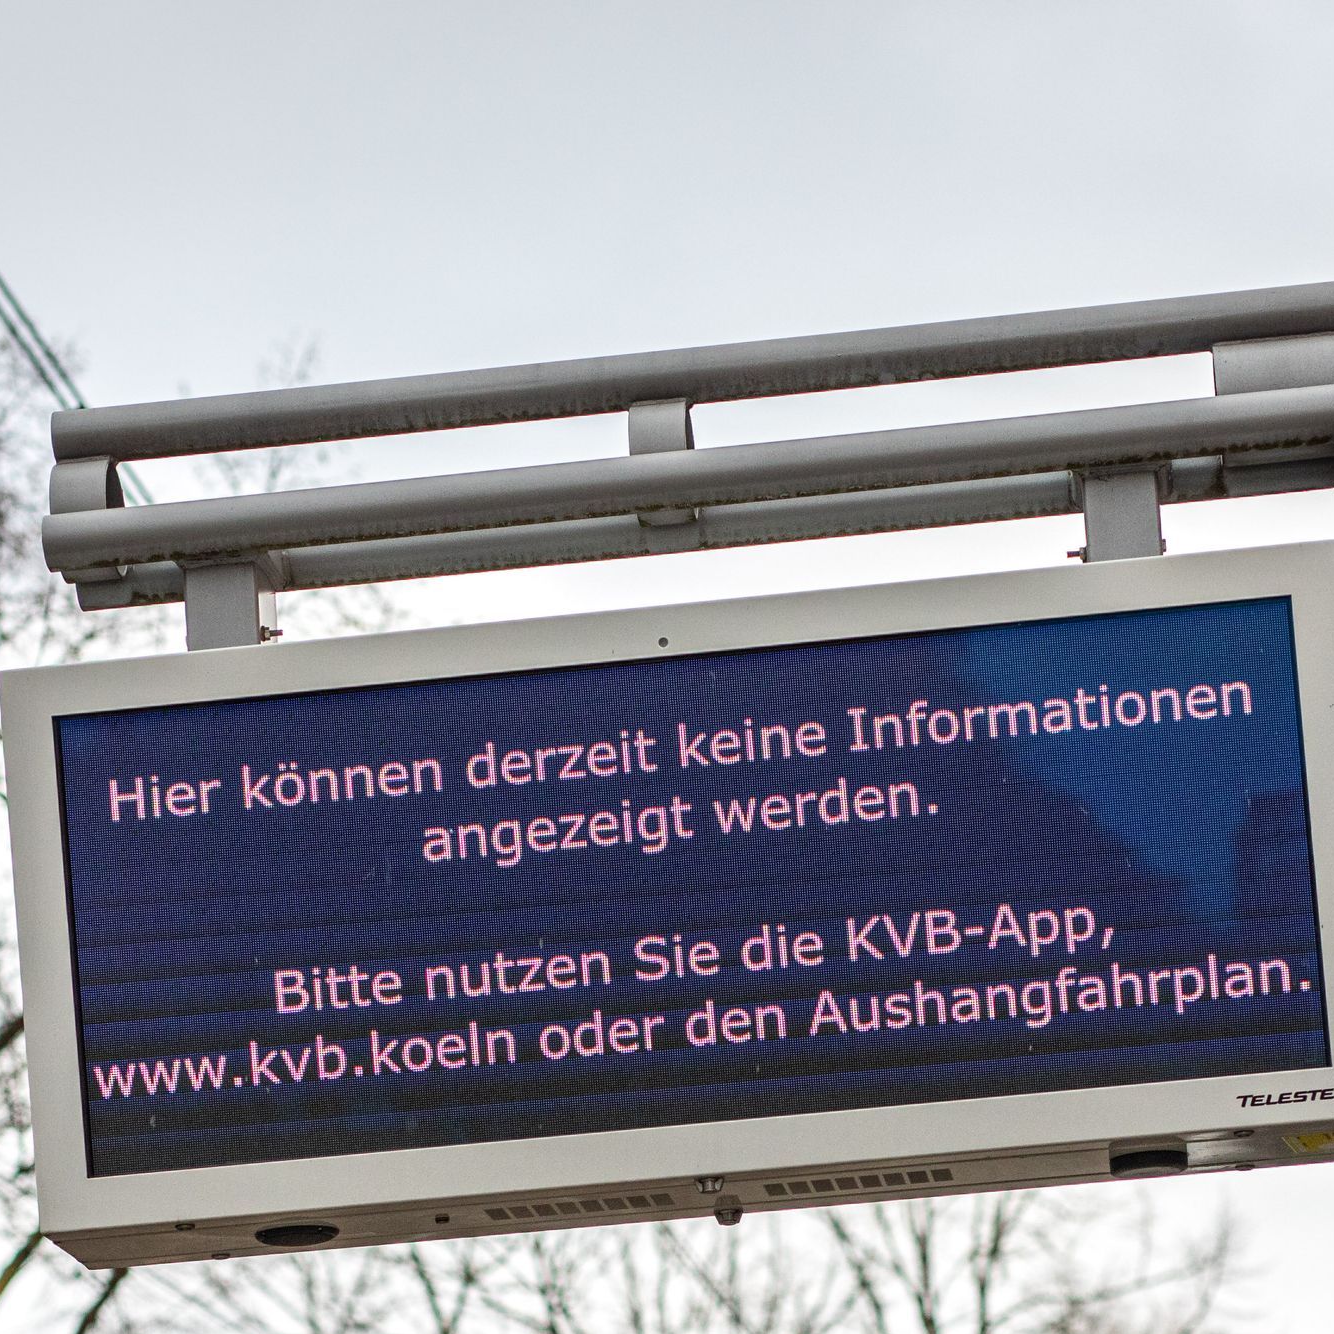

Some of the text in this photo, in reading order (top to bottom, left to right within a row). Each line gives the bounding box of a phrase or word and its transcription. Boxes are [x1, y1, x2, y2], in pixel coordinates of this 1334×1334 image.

[108, 679, 1253, 823] Hier können derzeit keine Informationen
[420, 776, 940, 869] angezeigt werden.
[272, 902, 1116, 1014] Bitte nutzen Sie die KVB-App,
[92, 953, 1312, 1101] www.kvb.koeln oder den Aushangfahrplan.
